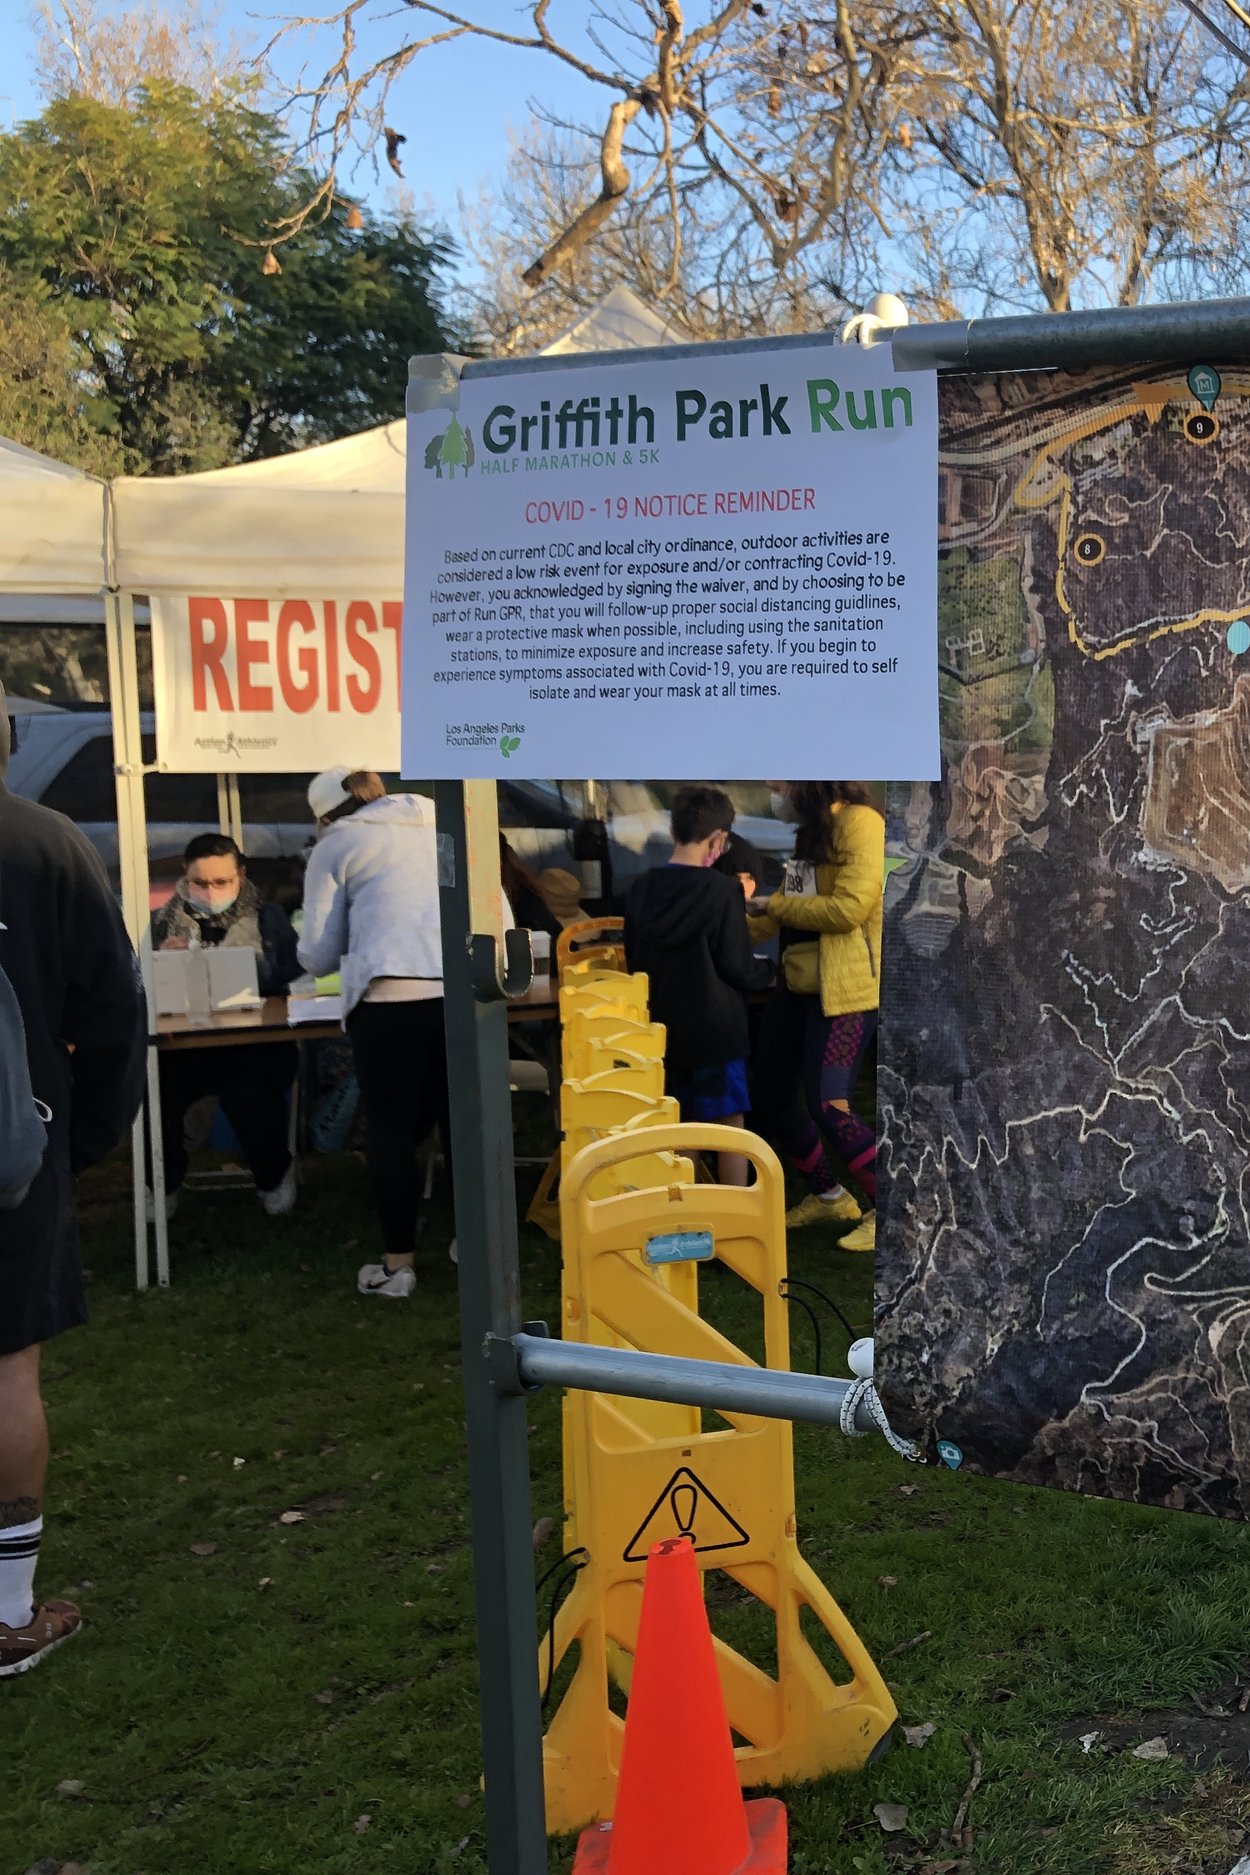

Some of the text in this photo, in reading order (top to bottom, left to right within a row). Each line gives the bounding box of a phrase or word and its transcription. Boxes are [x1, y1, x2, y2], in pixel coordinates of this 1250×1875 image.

[481, 378, 914, 455] Griffith Park Run
[1196, 421, 1204, 434] 9
[481, 449, 660, 475] HALF MARATHON & 5K
[525, 500, 584, 525] COVID
[604, 497, 628, 520] 19
[634, 493, 708, 518] NOTICE
[714, 487, 816, 515] REMINDER
[444, 531, 890, 562] Based on current CDC and local city ordinance, outdoor activities are
[1084, 544, 1091, 555] 8
[437, 550, 896, 582] considered a low risk event for exposure and/or contracting Covid-19.
[430, 572, 905, 605] However, you acknowledged by signing the waiver, and by choosing to be
[432, 595, 900, 625] part of Run GPR, that you will follow-up proper social distancing guidlines,
[445, 616, 883, 643] wear a protective mask when possible, including using the sanitation
[450, 638, 876, 664] stations, to minimize exposure and increase safety. If you begin to
[433, 659, 898, 684] experience symptoms associated with Covid-19, you are required to self
[529, 682, 780, 700] isolate and wear your mask at all times.
[446, 722, 525, 736] Los Angeles Parks
[446, 735, 497, 745] Foundation
